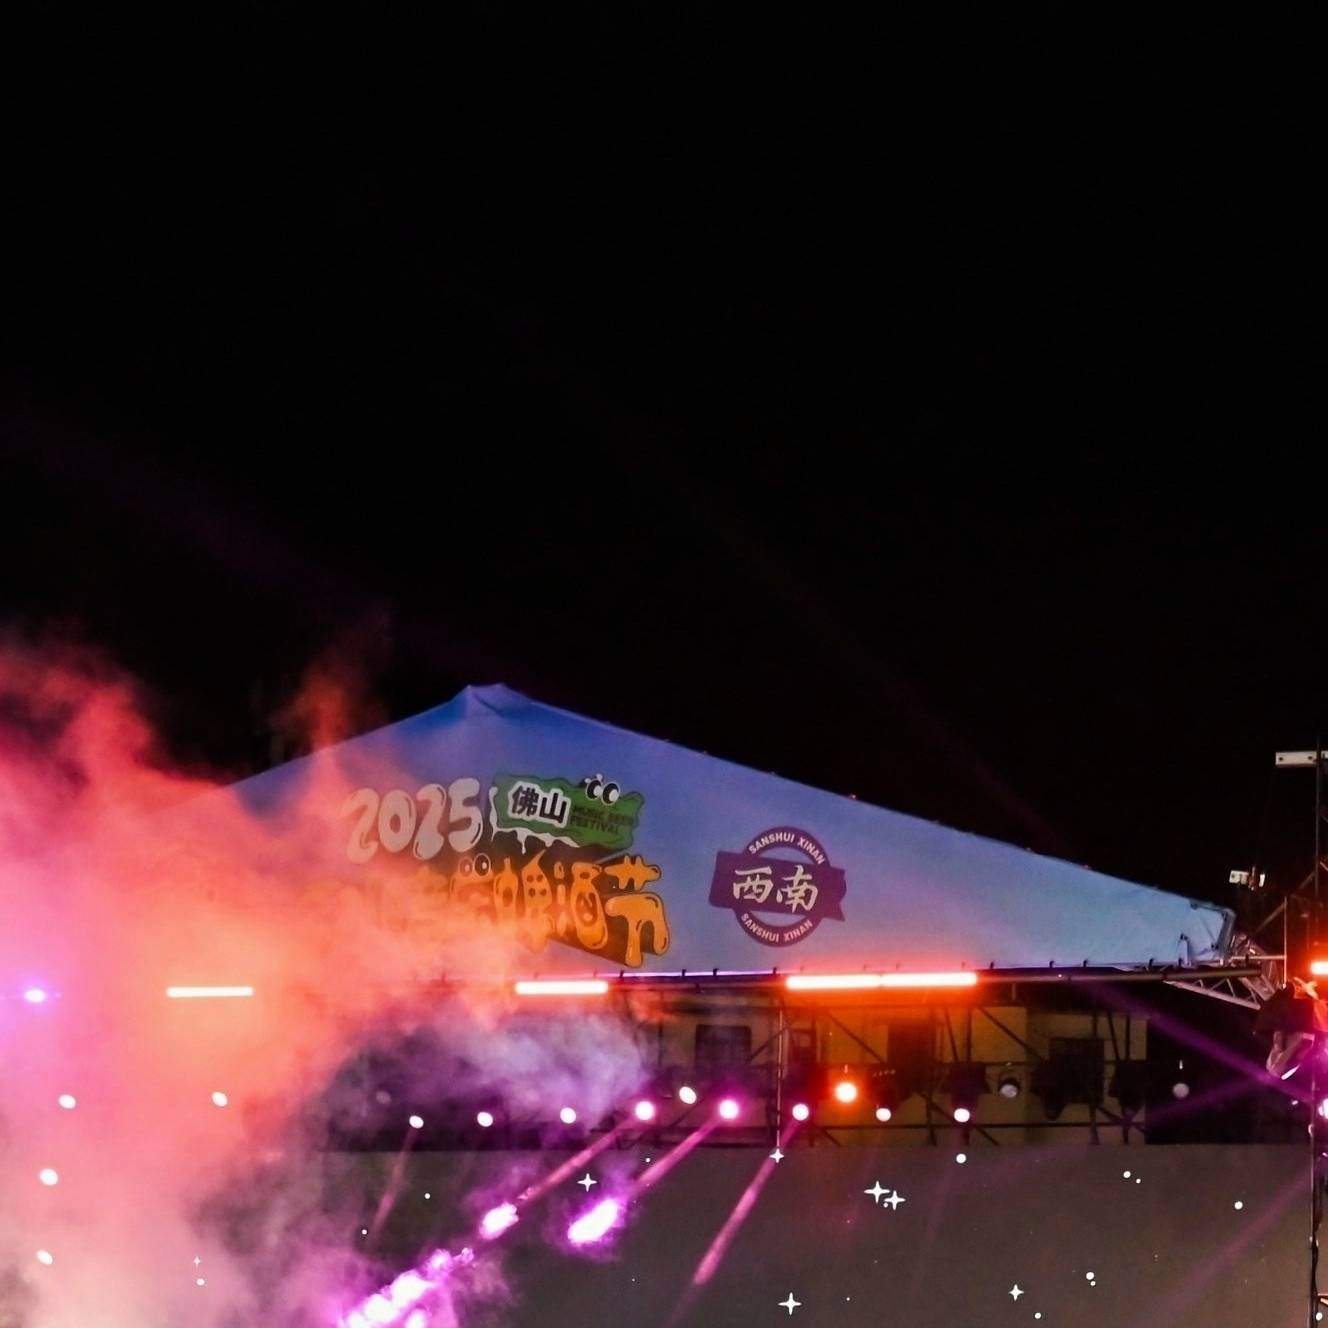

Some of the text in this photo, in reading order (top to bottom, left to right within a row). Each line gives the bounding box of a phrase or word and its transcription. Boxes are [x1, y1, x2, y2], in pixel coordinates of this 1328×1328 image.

[339, 778, 484, 864] 2025
[512, 785, 568, 824] 佛山
[748, 832, 825, 865] SANSHUI XINAN
[733, 864, 819, 913] 西南
[741, 913, 814, 942] SANSHUI XINAN
